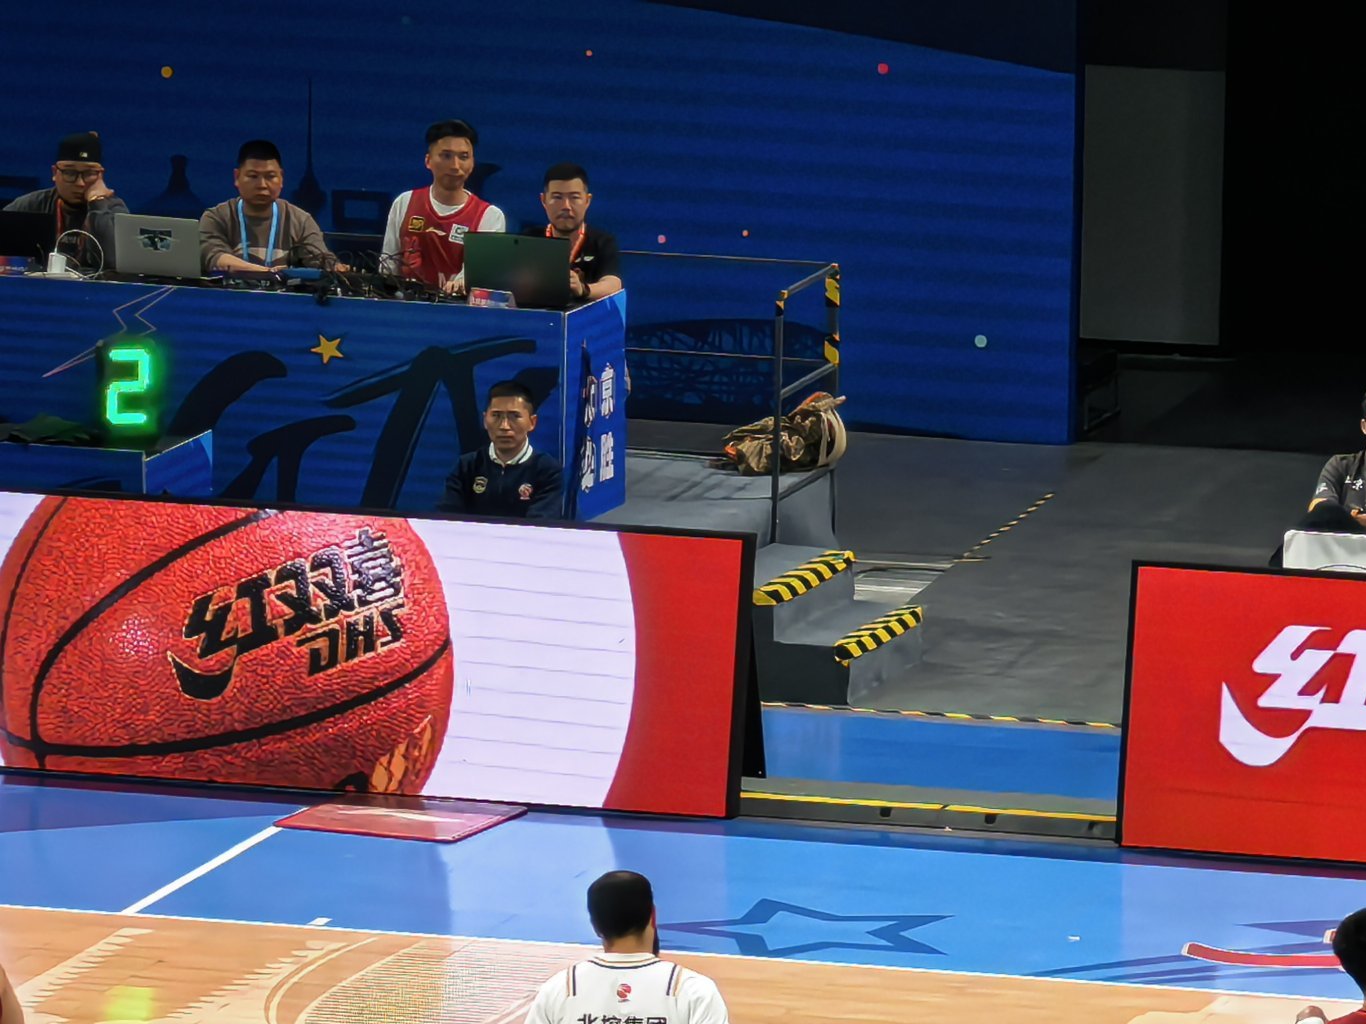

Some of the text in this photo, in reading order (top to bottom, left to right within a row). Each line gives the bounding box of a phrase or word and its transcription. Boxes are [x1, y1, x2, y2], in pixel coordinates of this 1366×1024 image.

[106, 349, 150, 425] 2
[167, 526, 405, 700] 红双喜
[295, 607, 403, 677] DHS
